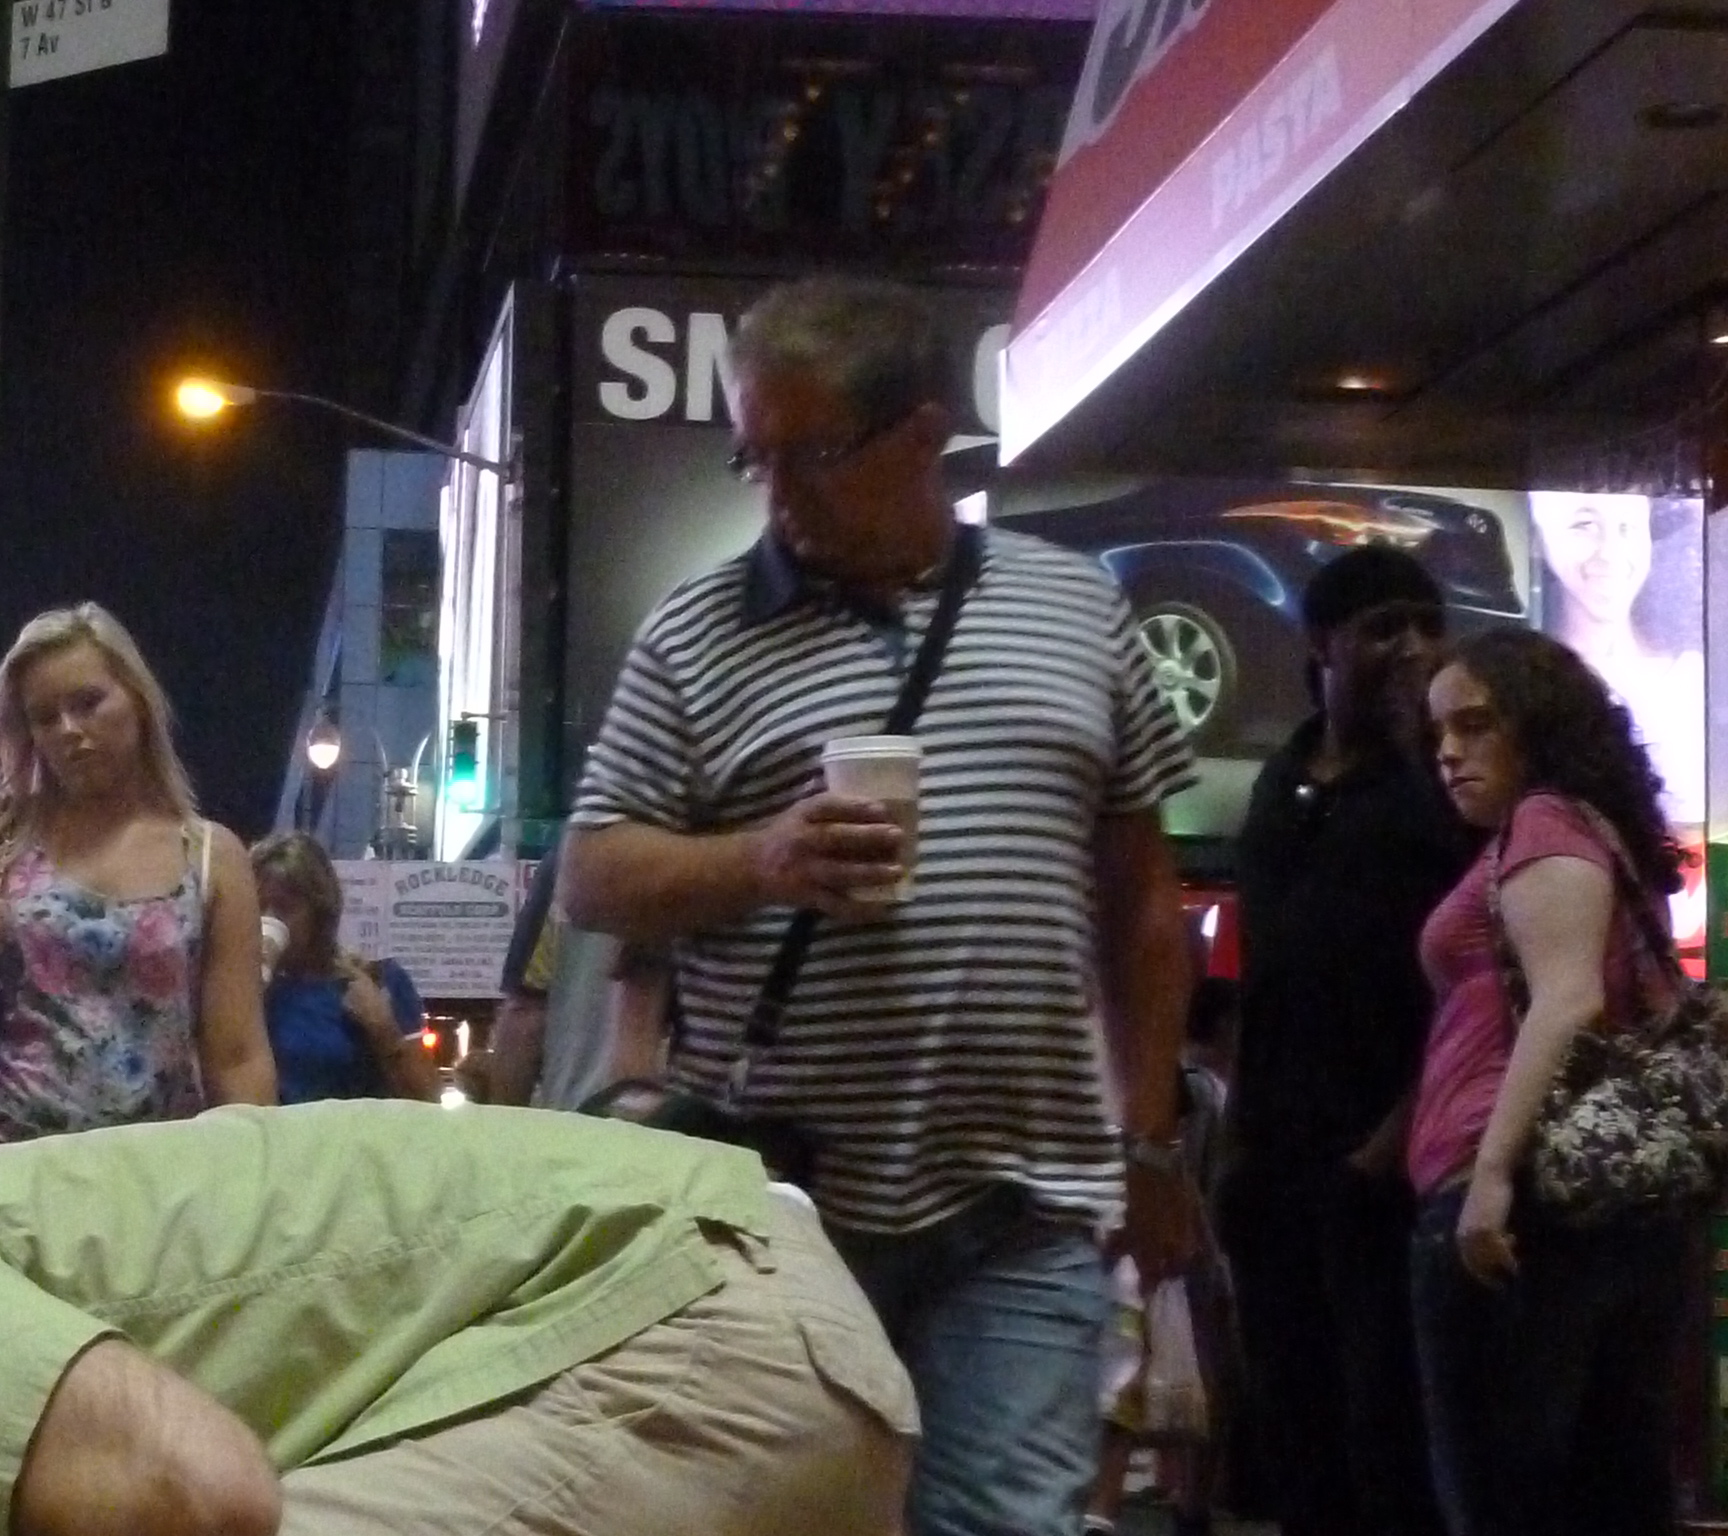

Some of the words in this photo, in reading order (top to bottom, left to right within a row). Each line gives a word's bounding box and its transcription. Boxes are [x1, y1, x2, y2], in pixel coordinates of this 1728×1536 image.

[21, 4, 39, 28] W
[19, 36, 31, 61] 7
[38, 30, 61, 57] Av
[1211, 42, 1343, 228] PASTA
